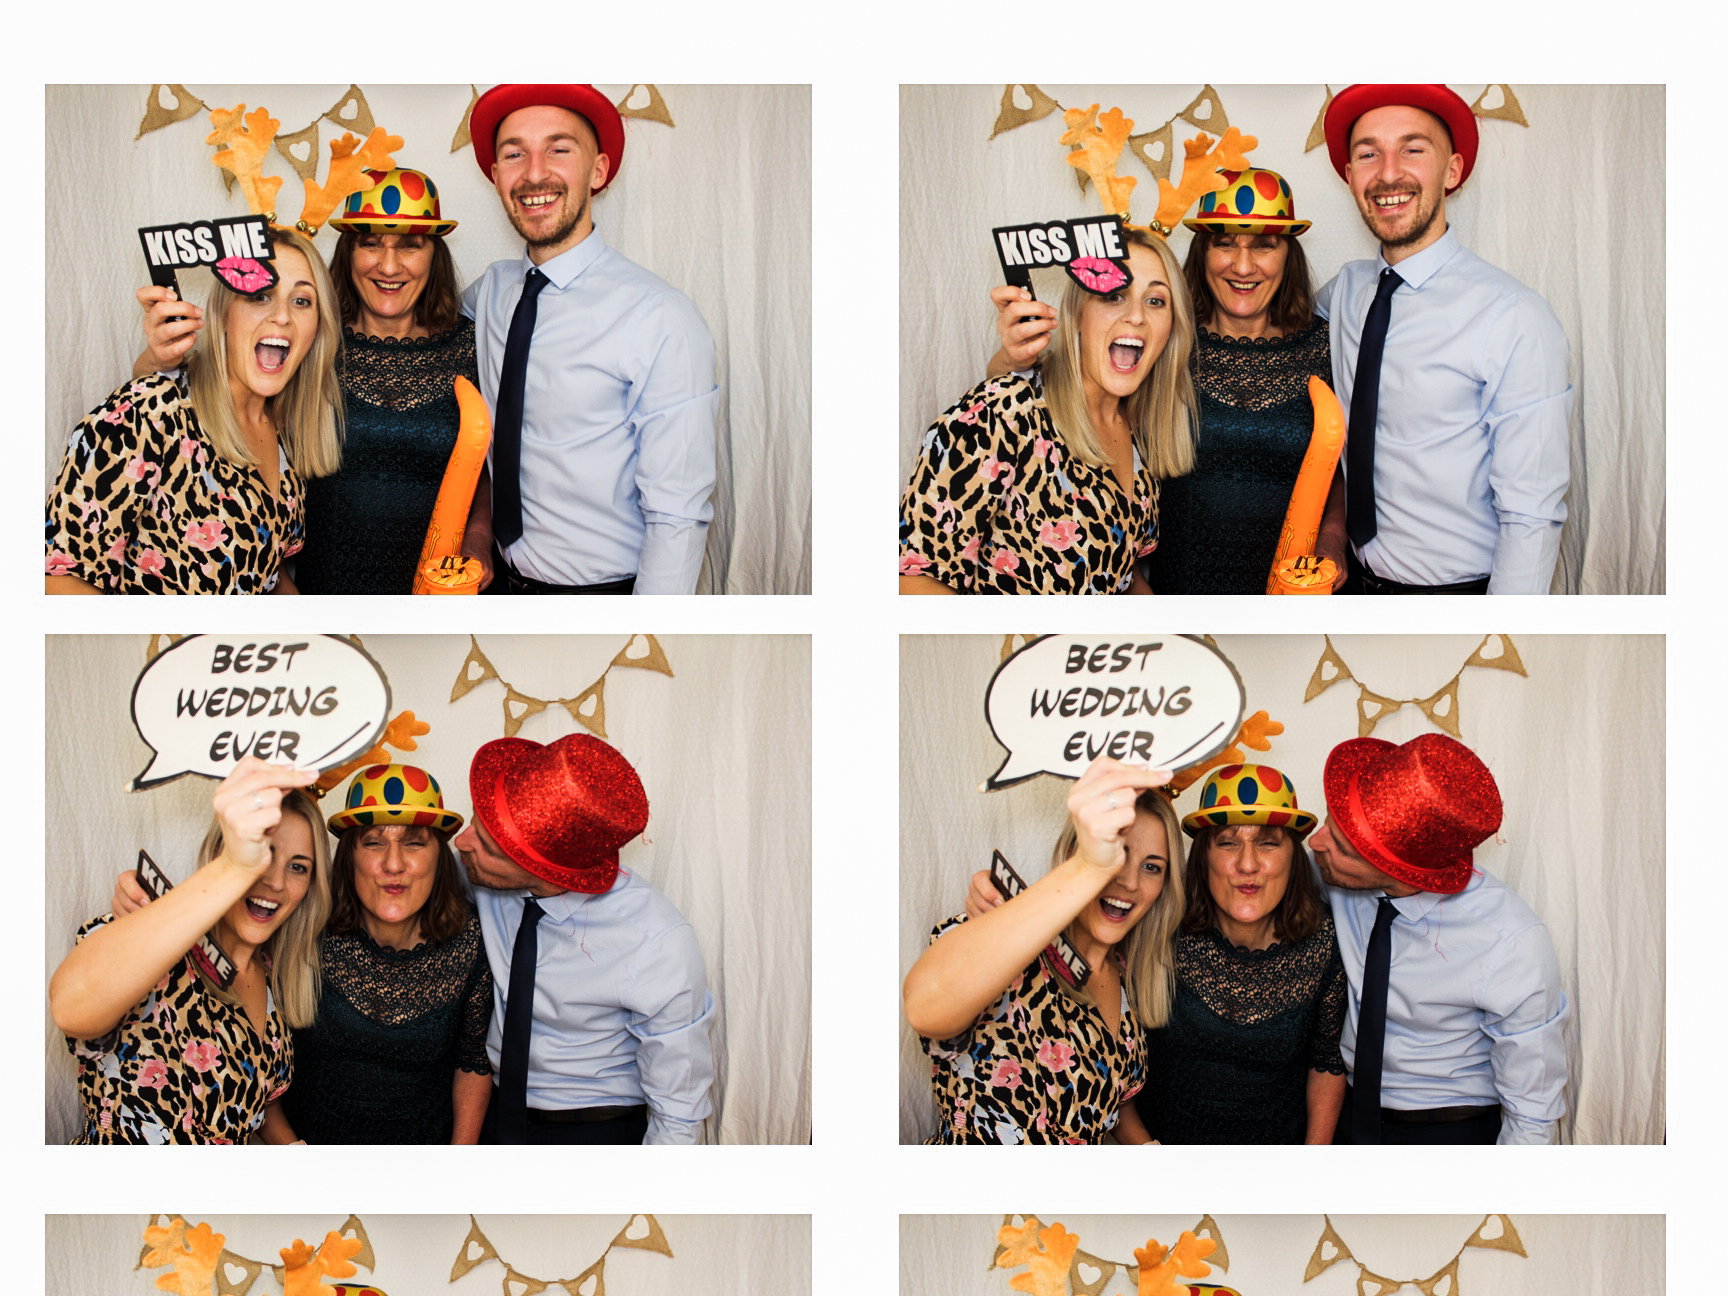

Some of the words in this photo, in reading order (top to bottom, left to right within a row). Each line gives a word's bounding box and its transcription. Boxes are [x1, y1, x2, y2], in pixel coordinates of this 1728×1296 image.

[144, 226, 218, 266] KISS
[219, 222, 270, 258] ME
[998, 226, 1072, 266] KISS
[1073, 222, 1124, 258] ME
[211, 642, 309, 674] BEST
[1065, 642, 1163, 674] BEST
[177, 686, 339, 718] WEDDING
[1031, 686, 1193, 718] WEDDING
[209, 731, 300, 762] EVER
[1063, 731, 1154, 762] EVER
[141, 857, 174, 898] KI
[995, 857, 1028, 898] KI
